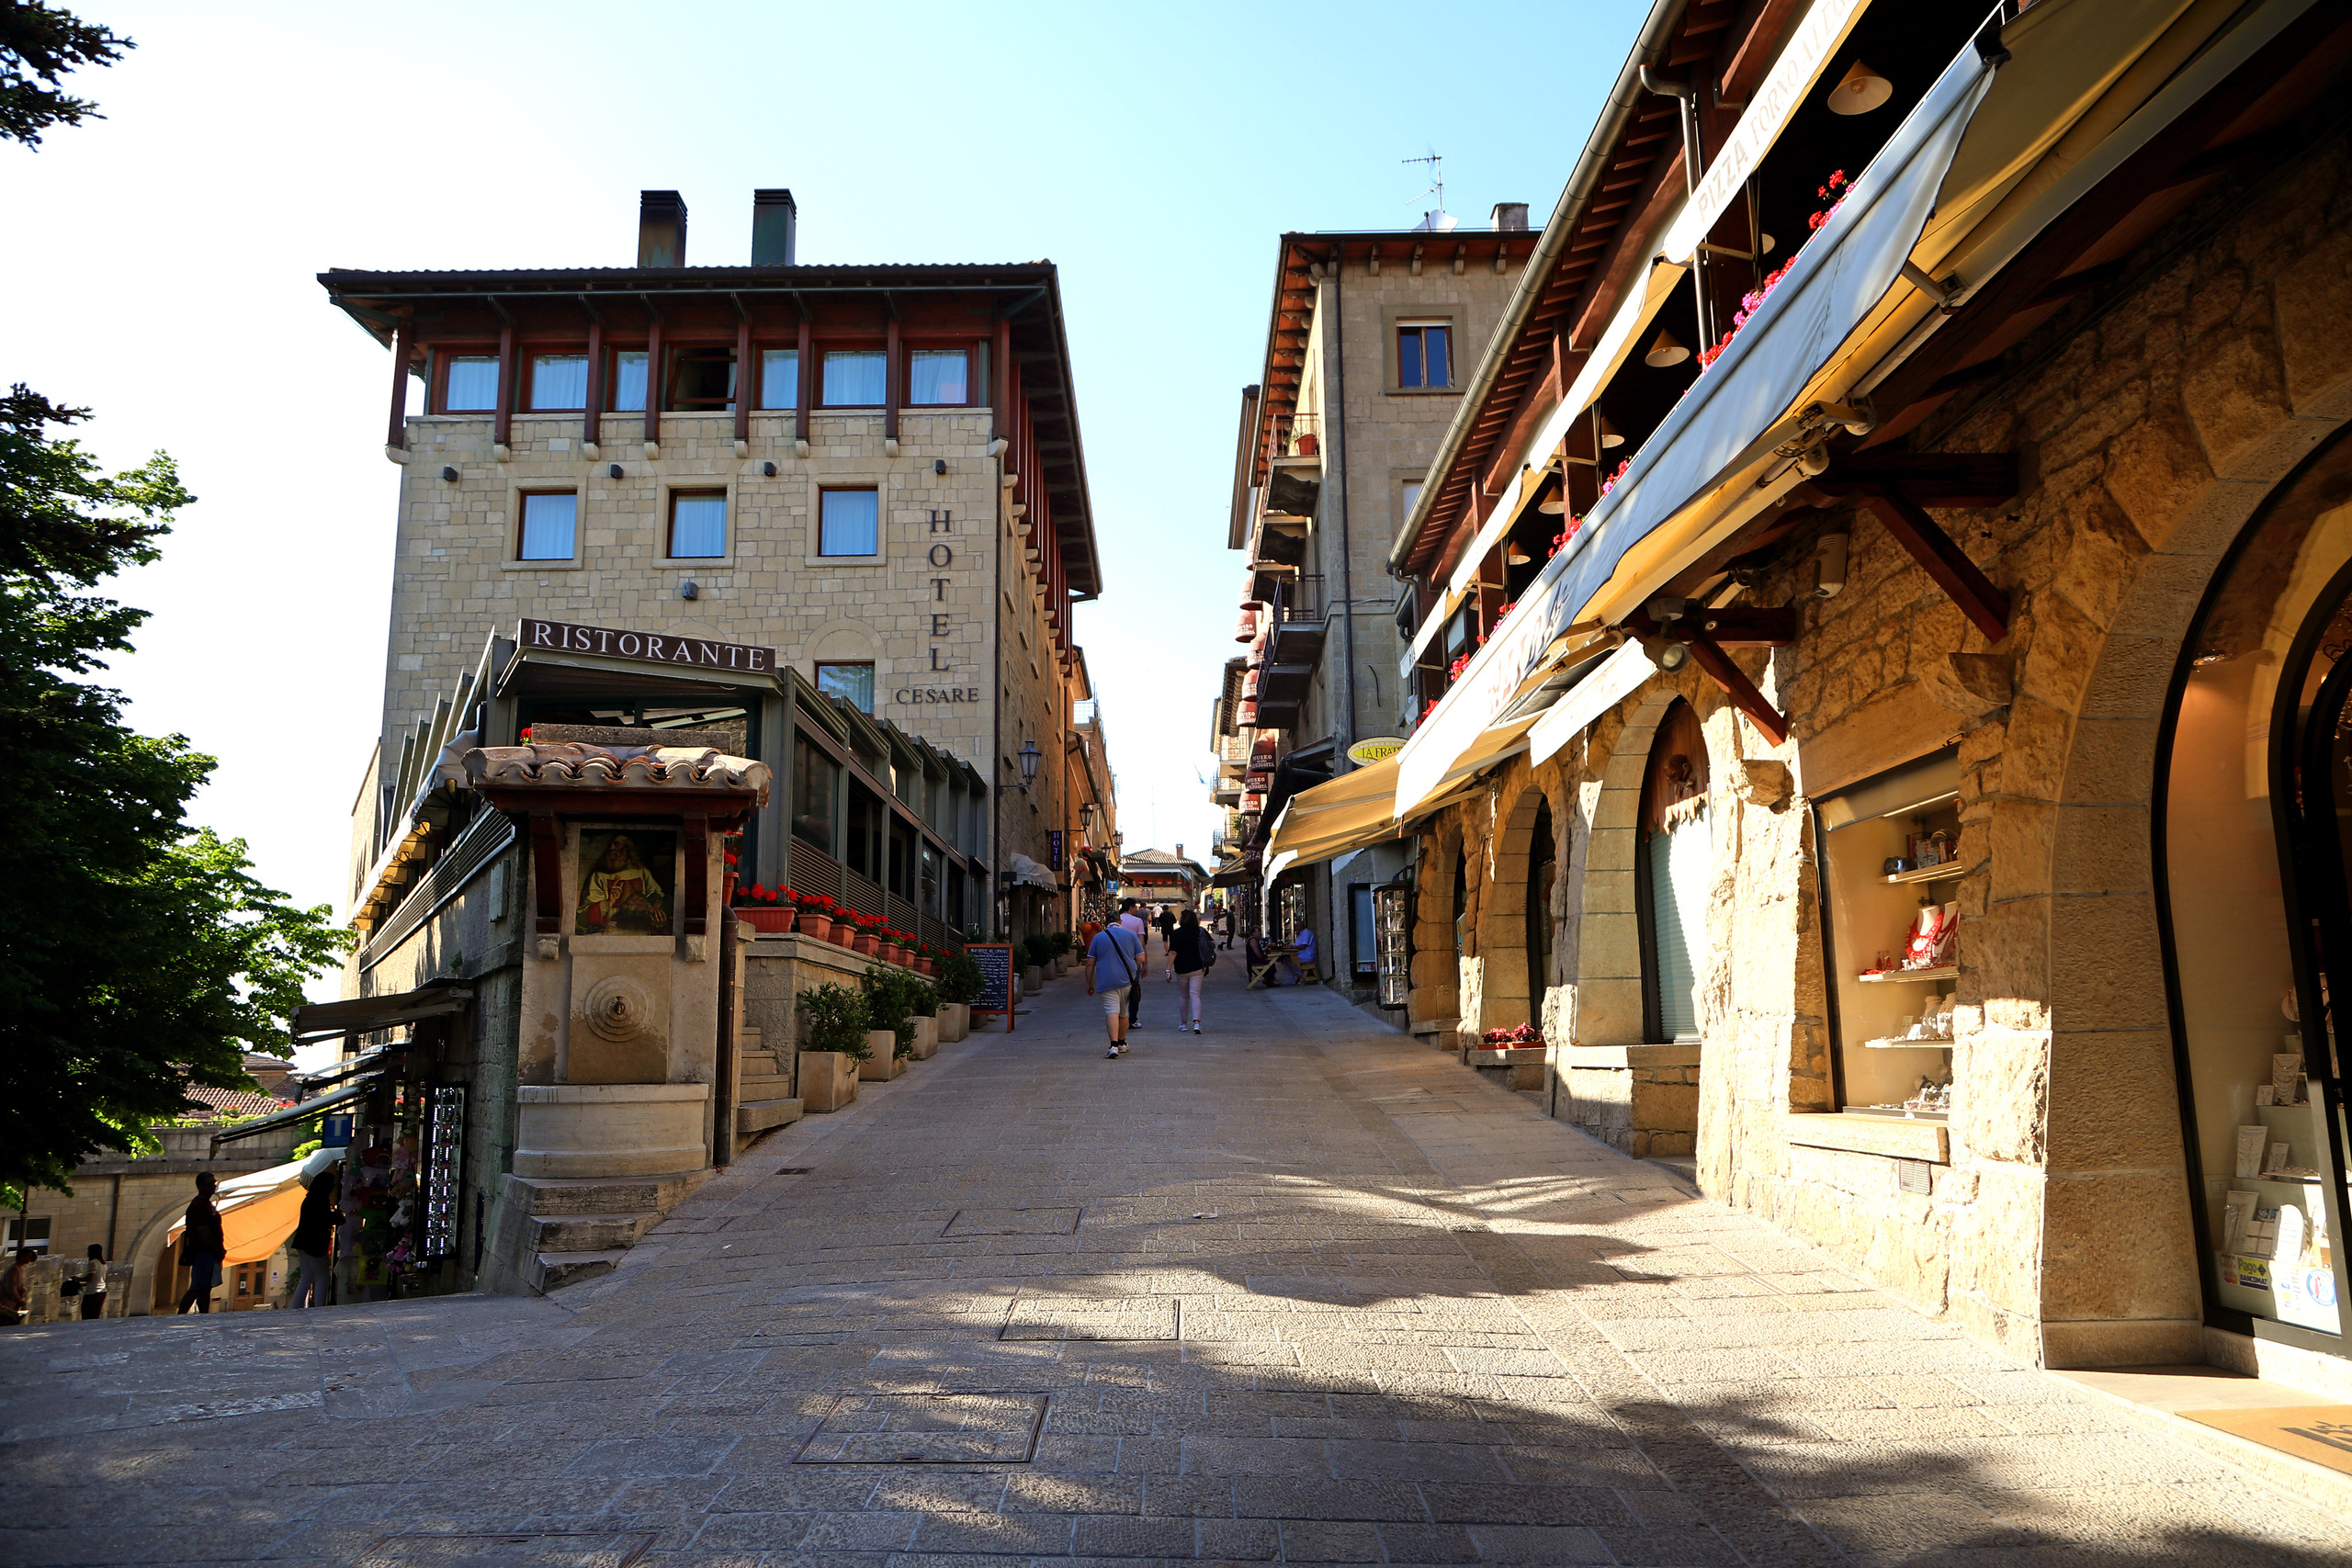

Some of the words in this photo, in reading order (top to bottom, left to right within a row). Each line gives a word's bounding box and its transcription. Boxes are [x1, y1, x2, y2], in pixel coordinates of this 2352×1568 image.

[1698, 139, 1748, 224] PIZZA
[1749, 60, 1799, 147] FORNO
[1811, 0, 1851, 51] LEG
[929, 509, 953, 671] HOTEL
[533, 622, 765, 671] RISTORANTE
[896, 687, 979, 705] CESARE
[1362, 748, 1374, 758] LA
[1109, 880, 1116, 889] T
[329, 1115, 348, 1136] T
[2237, 1257, 2257, 1275] Pago
[2240, 1273, 2268, 1285] BANCOMAT
